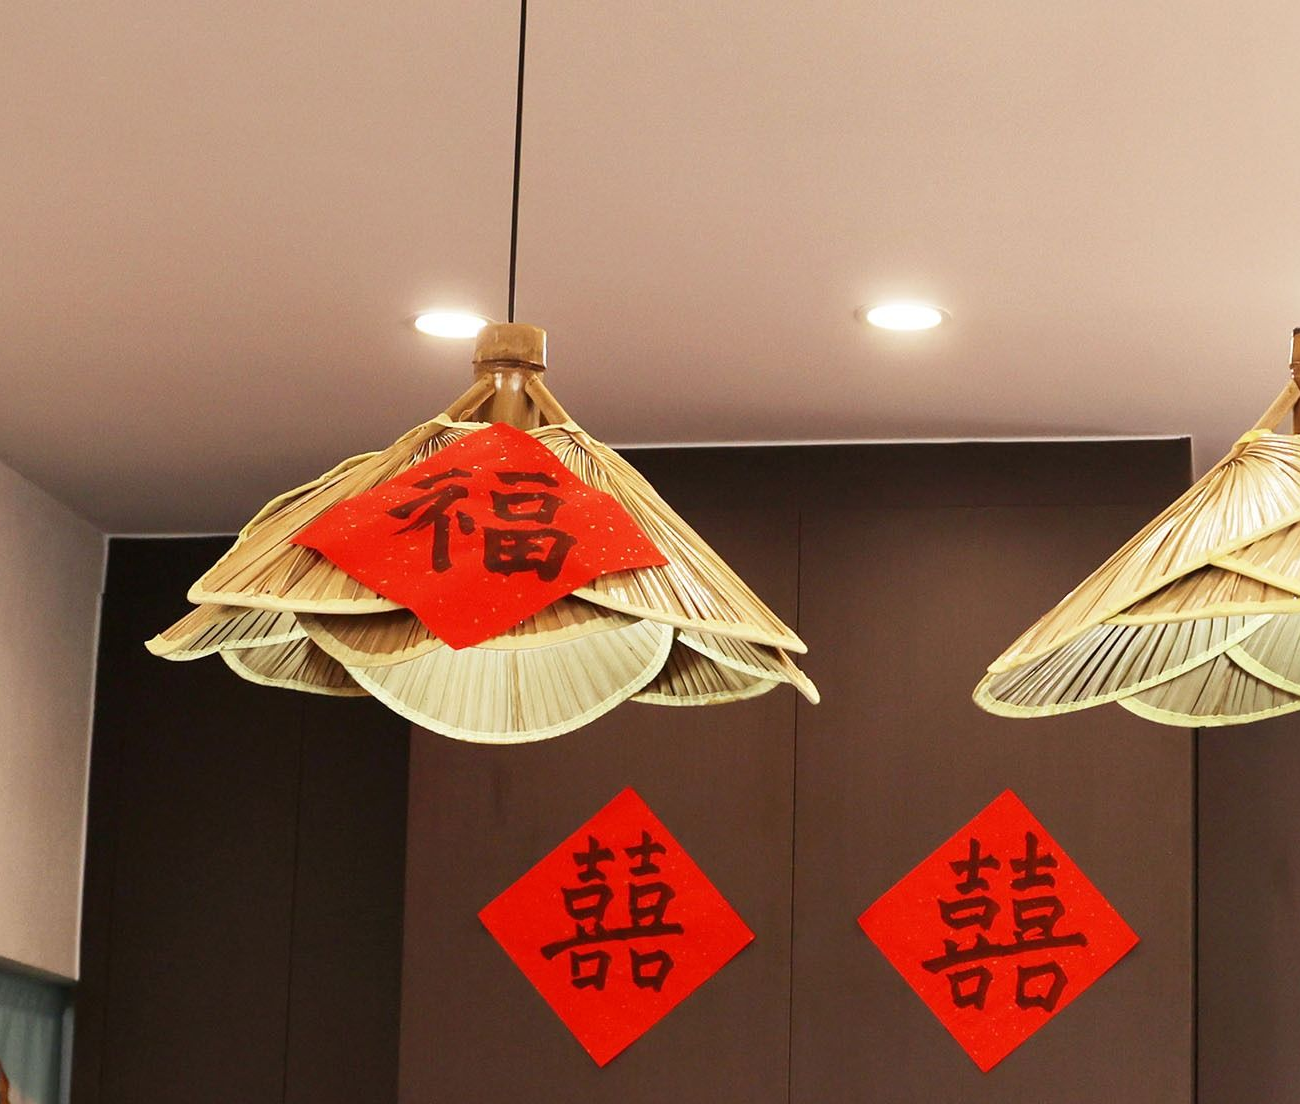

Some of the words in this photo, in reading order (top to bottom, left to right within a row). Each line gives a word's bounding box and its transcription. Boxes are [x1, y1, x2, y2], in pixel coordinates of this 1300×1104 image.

[387, 467, 578, 582] 福
[541, 829, 684, 993] 囍
[921, 830, 1088, 1013] 囍
